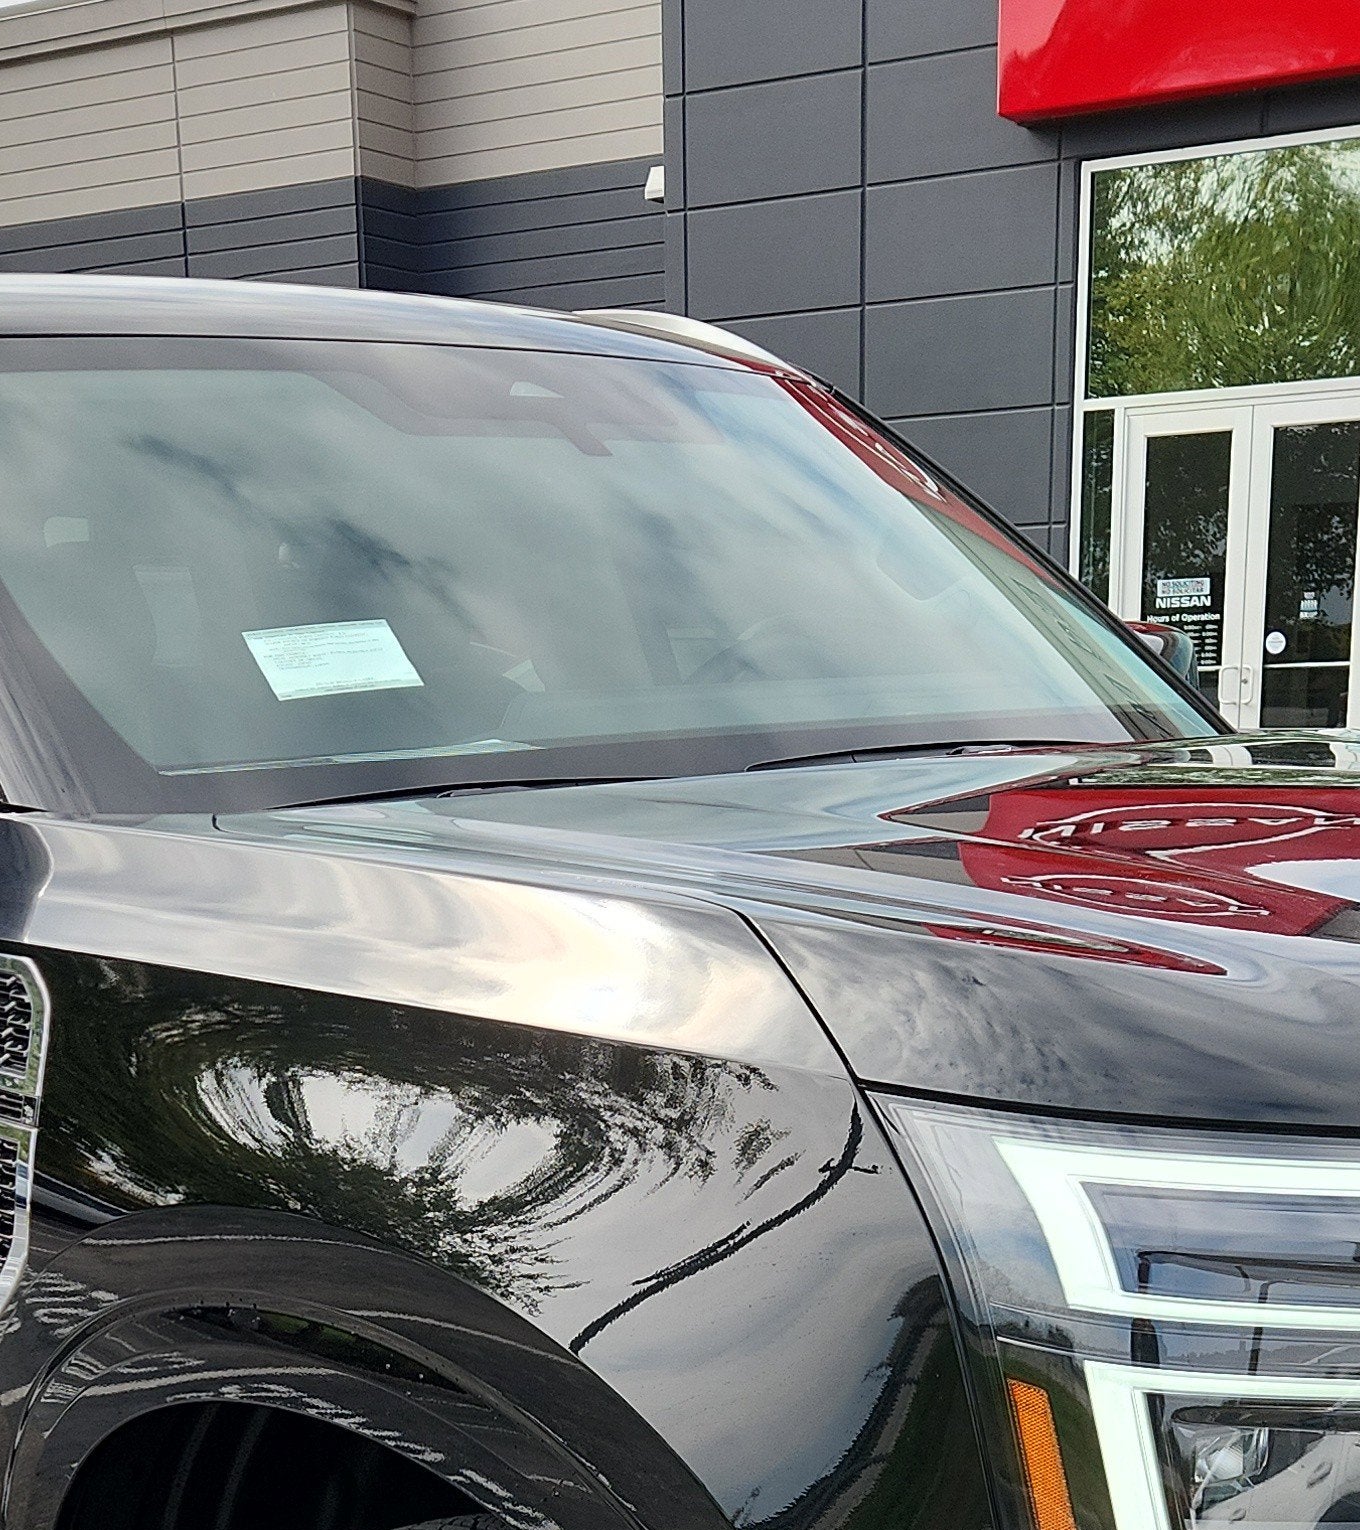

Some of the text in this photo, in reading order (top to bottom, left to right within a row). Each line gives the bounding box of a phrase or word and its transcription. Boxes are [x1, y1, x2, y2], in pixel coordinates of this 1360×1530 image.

[1155, 595, 1212, 609] NISSAN
[1146, 612, 1221, 623] Hours of Operation
